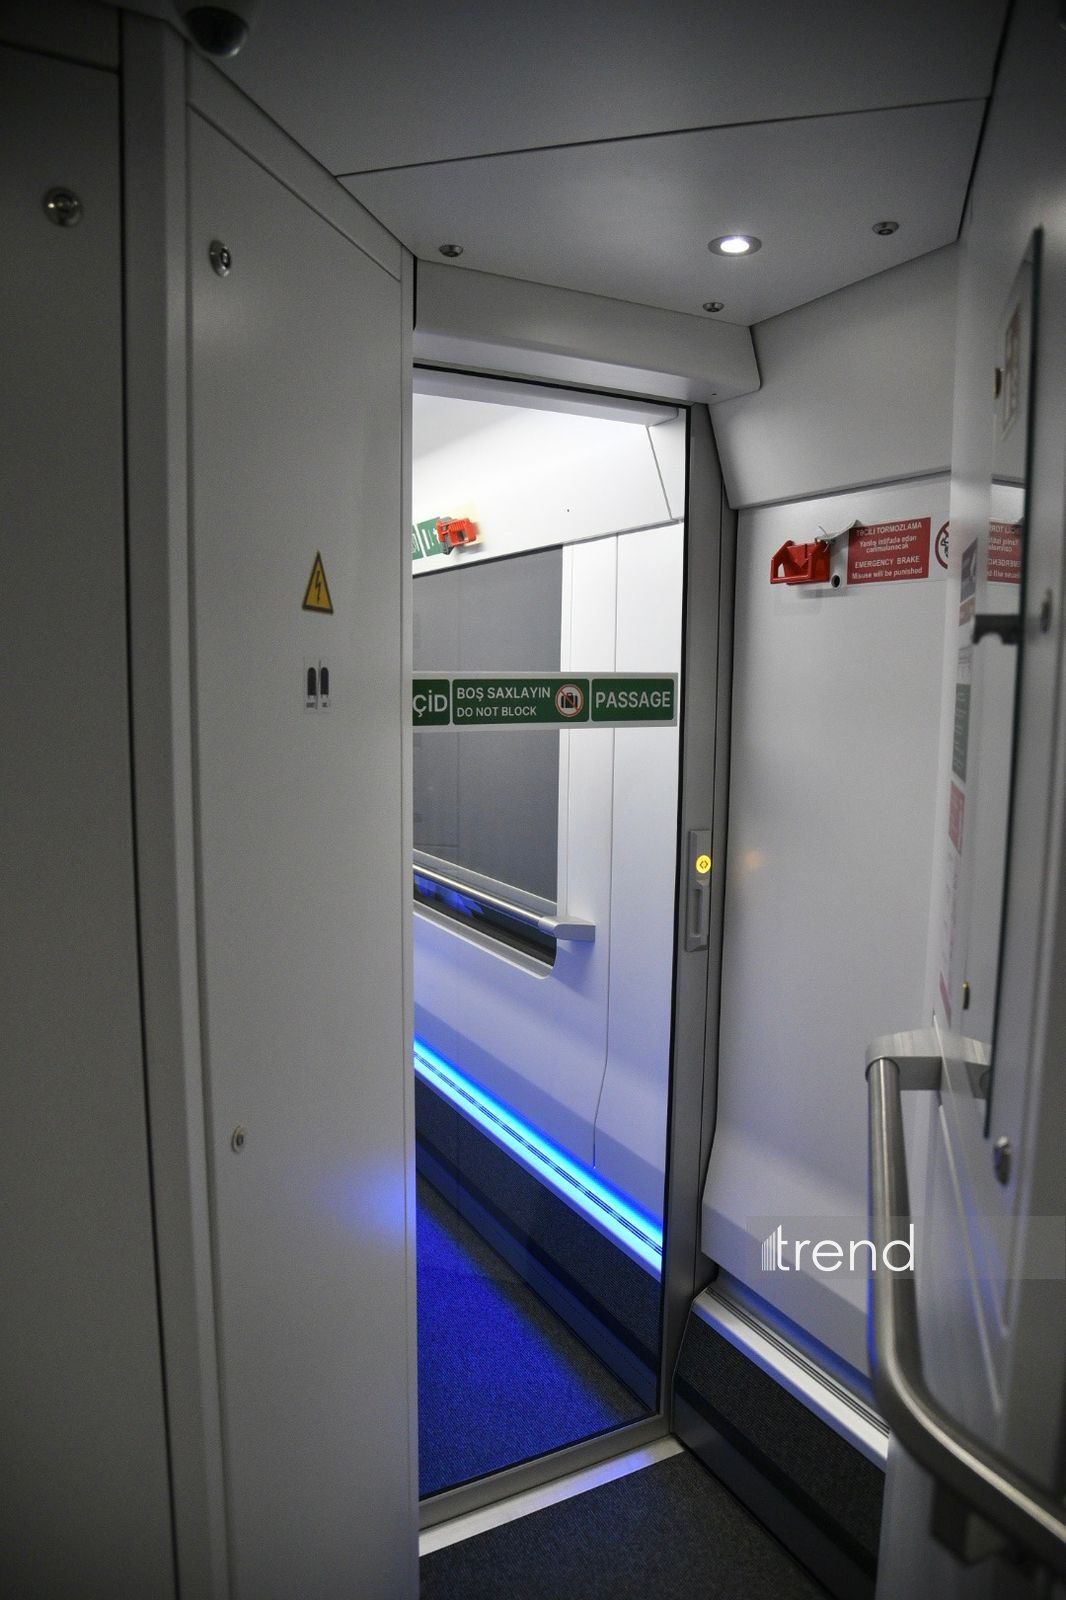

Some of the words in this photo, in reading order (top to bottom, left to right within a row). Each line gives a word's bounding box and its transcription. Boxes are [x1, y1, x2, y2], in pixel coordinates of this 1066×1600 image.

[877, 521, 922, 534] TORMOZLAMA
[855, 558, 894, 569] EMERGENCY
[896, 556, 920, 565] BRAKE
[852, 571, 872, 579] Misuse
[884, 569, 893, 577] be
[893, 566, 923, 578] punished
[456, 687, 484, 702] BOŞ
[487, 686, 551, 699] SAXLAYIN
[595, 691, 671, 709] PASSAGE
[412, 689, 448, 717] ÇİD
[456, 707, 474, 717] DO
[475, 706, 500, 717] NOT
[501, 706, 537, 717] BLOCK
